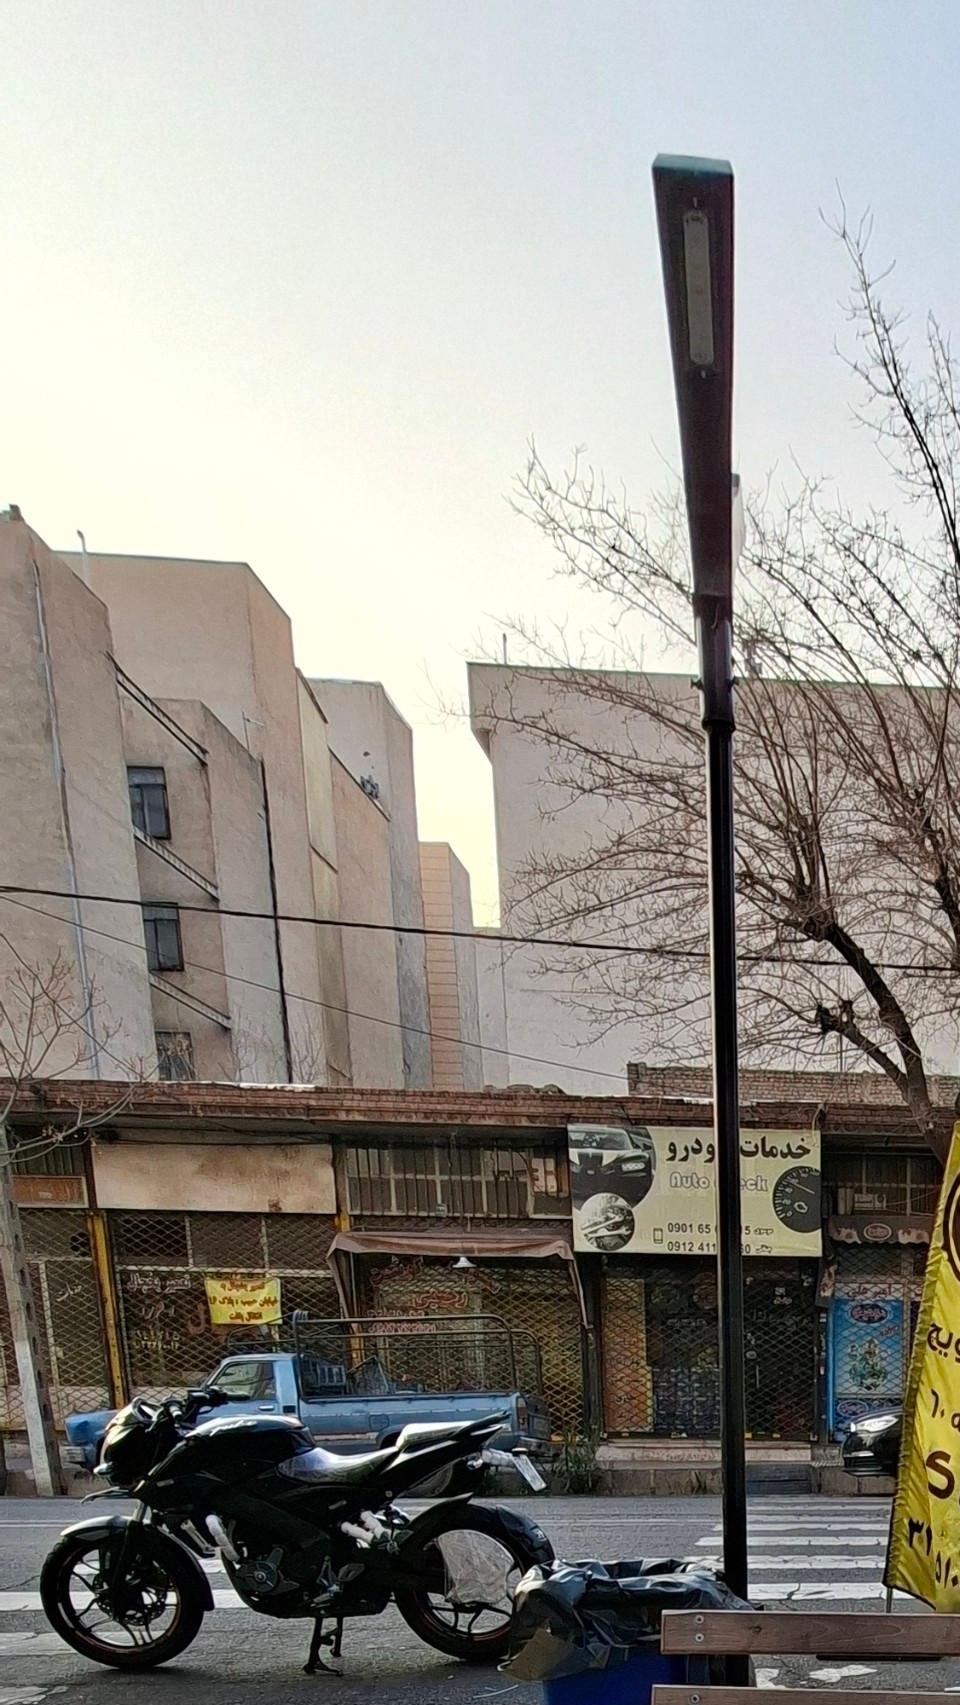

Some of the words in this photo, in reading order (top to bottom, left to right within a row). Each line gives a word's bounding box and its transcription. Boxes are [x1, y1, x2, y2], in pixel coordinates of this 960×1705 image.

[665, 1137, 716, 1163] ودرو
[739, 1136, 811, 1159] خدمات
[670, 1171, 710, 1189] Auto
[667, 1222, 693, 1233] 0901
[667, 1241, 694, 1252] 0912
